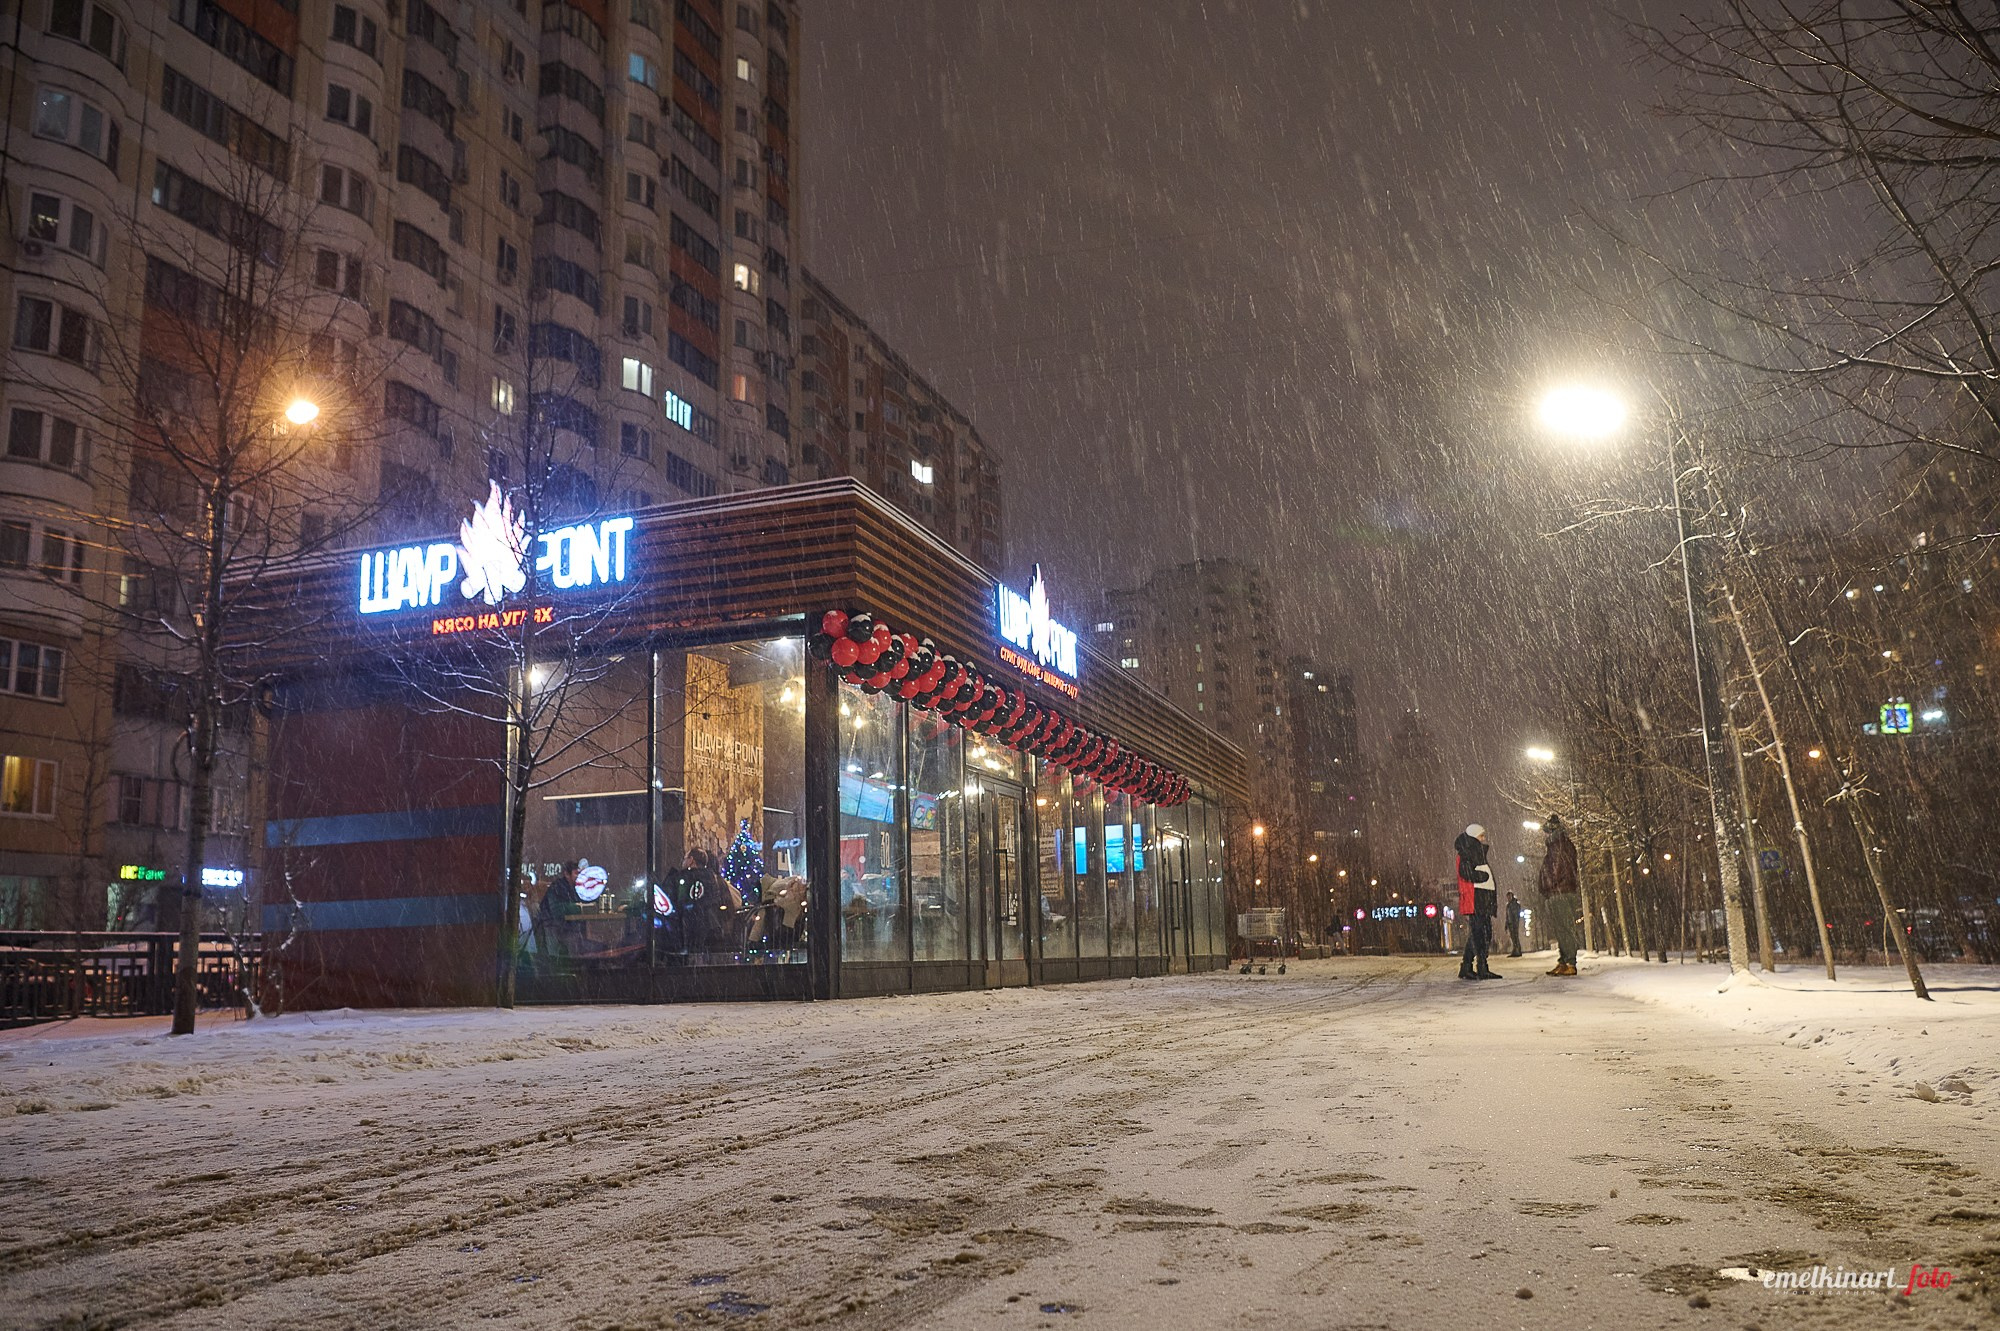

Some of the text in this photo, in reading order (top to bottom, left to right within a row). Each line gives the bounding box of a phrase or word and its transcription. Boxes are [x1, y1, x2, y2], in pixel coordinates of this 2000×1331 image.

[432, 607, 554, 635] МЯСО НА УГЯХ
[734, 740, 763, 764] POINT
